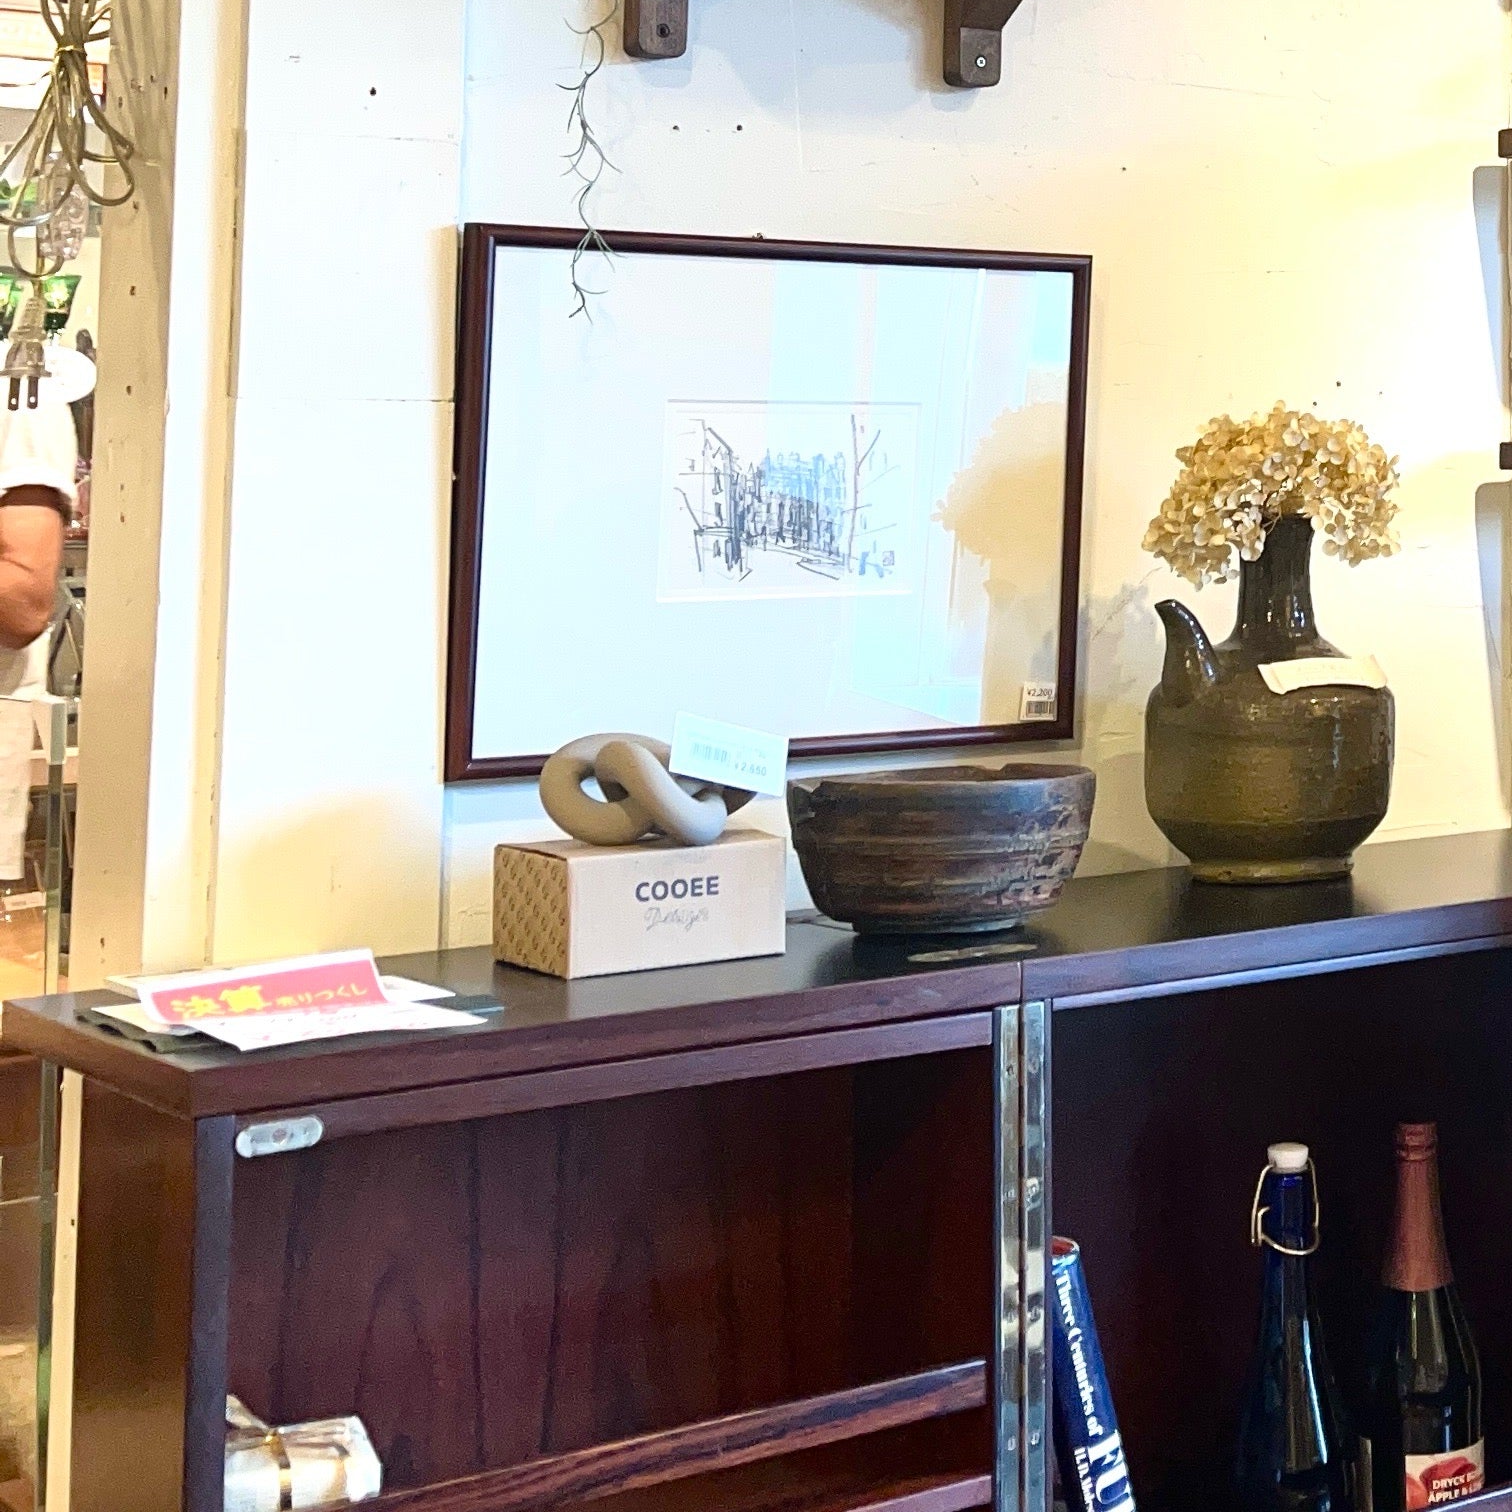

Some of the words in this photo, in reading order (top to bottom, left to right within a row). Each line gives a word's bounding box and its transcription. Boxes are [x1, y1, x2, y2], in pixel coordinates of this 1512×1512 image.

[635, 875, 720, 902] COOEE
[1056, 1270, 1075, 1326] Three
[1068, 1327, 1094, 1416] Centuries
